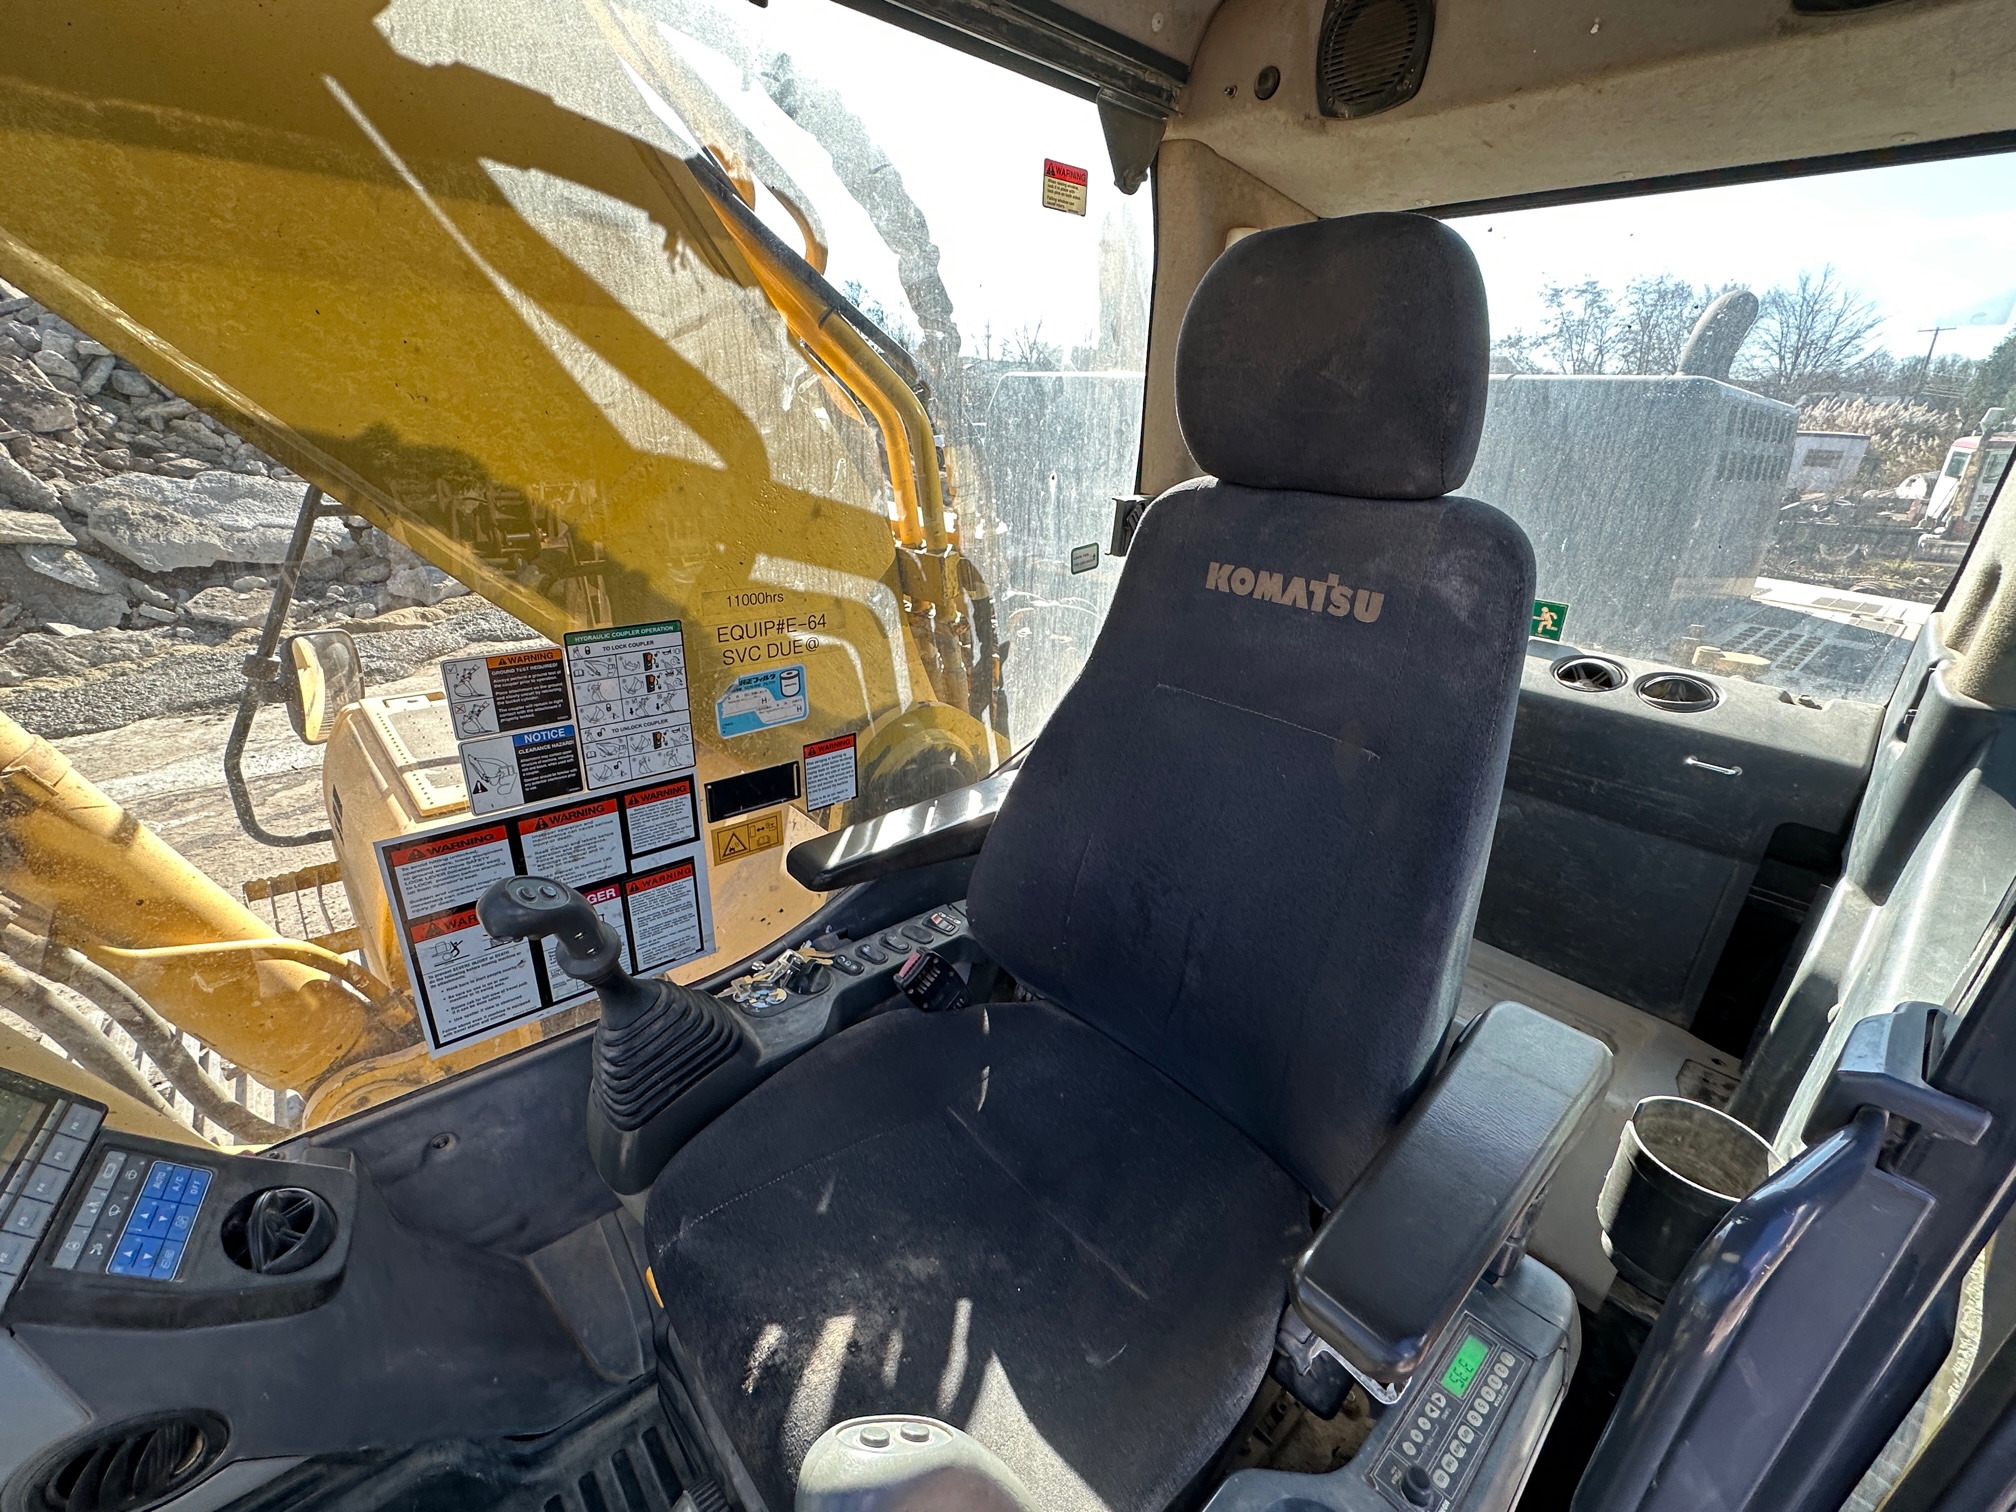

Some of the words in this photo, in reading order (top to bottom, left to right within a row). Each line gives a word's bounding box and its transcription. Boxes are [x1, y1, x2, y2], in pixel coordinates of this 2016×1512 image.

[1056, 166, 1086, 182] WARNING
[727, 592, 784, 608] 11000hrs
[1205, 561, 1384, 623] KOMATSU
[574, 632, 610, 642] HYDRAULIC
[610, 629, 640, 638] COUPLER
[640, 625, 673, 634] OPERATION
[627, 639, 654, 648] COUPLER
[507, 651, 554, 664] WARNING
[722, 646, 761, 665] SVC
[529, 662, 558, 670] REQUIRED!
[619, 723, 642, 732] UNLOCK
[642, 718, 668, 727] COUPLER
[523, 727, 565, 743] NOTICE
[518, 744, 551, 754] CLEARANCE
[551, 739, 574, 748] HAZARD!
[817, 738, 850, 752] WARNING
[640, 784, 686, 802] WARNING
[549, 803, 604, 825] WARNING
[426, 831, 494, 856] WARNING
[641, 866, 691, 887] WARNING
[153, 1172, 166, 1189] AUTO
[172, 1175, 184, 1191] A/C
[190, 1180, 201, 1195] OFF
